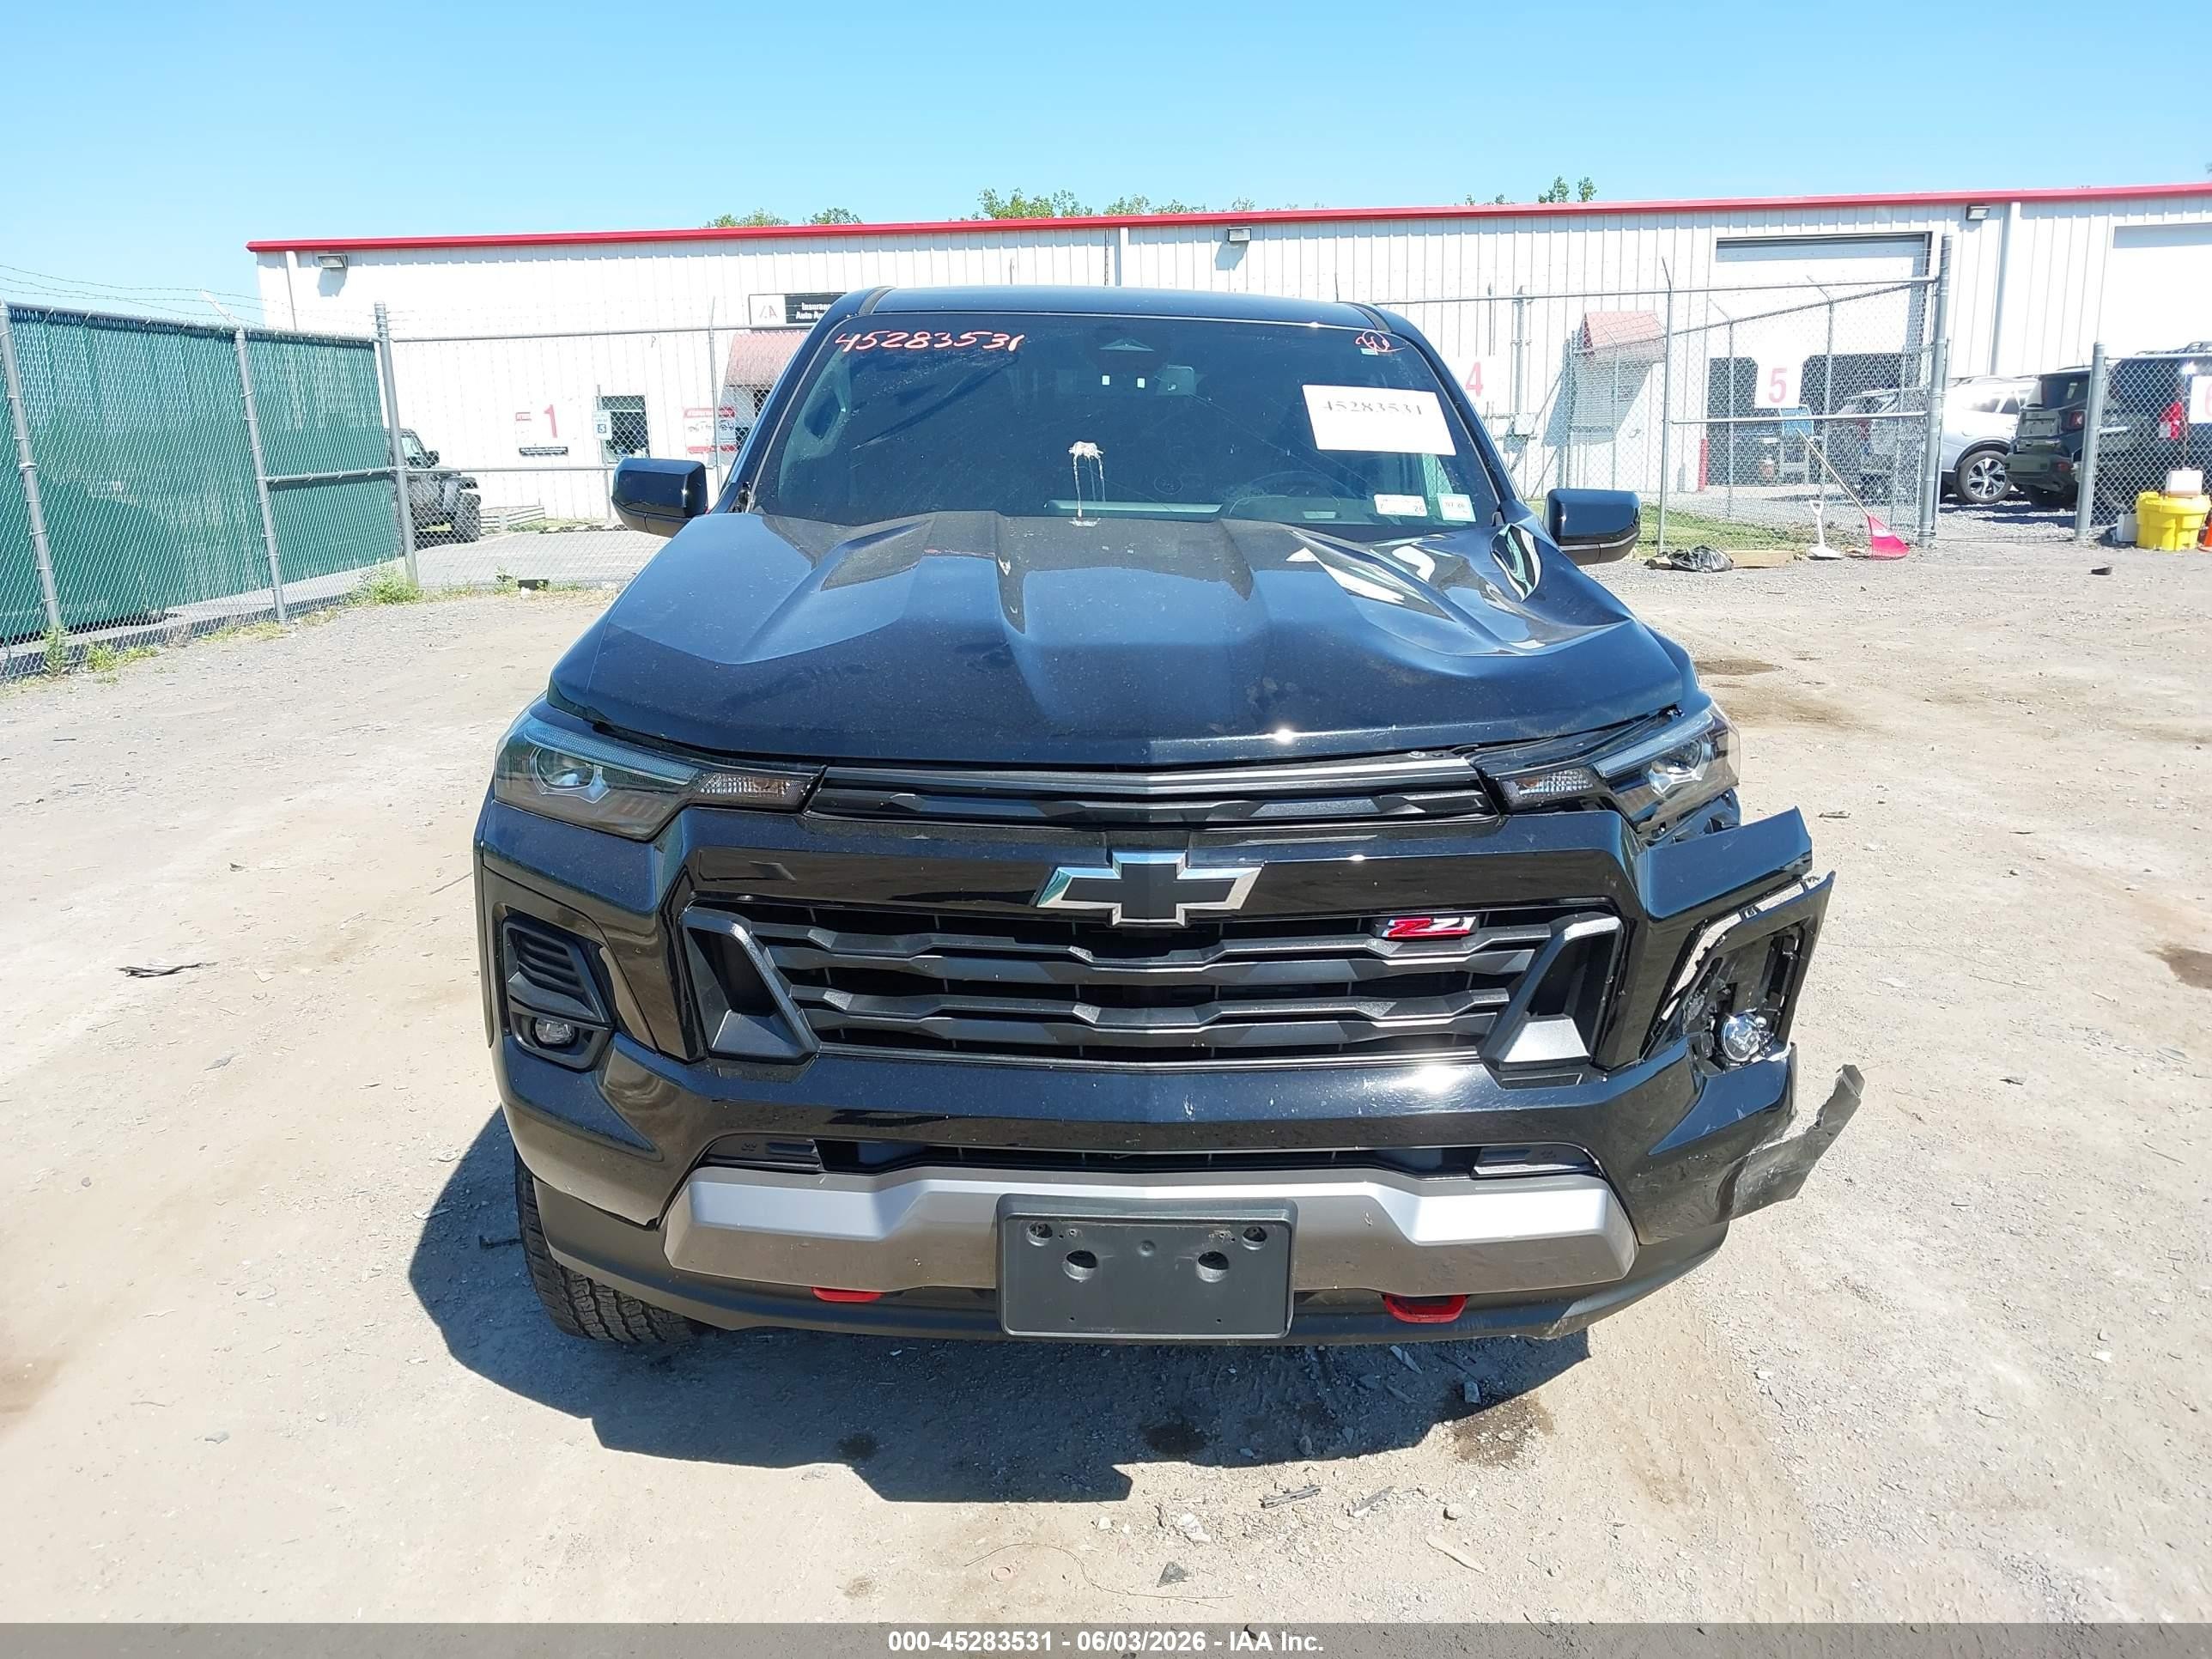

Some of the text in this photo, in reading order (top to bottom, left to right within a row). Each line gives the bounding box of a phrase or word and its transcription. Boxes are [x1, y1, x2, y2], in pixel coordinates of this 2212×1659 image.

[835, 331, 1025, 352] 45283531
[1465, 362, 1484, 397] 4
[1769, 368, 1787, 403] 5
[544, 404, 557, 438] 1
[1322, 400, 1422, 416] 45283531
[1381, 916, 1476, 939] Z71
